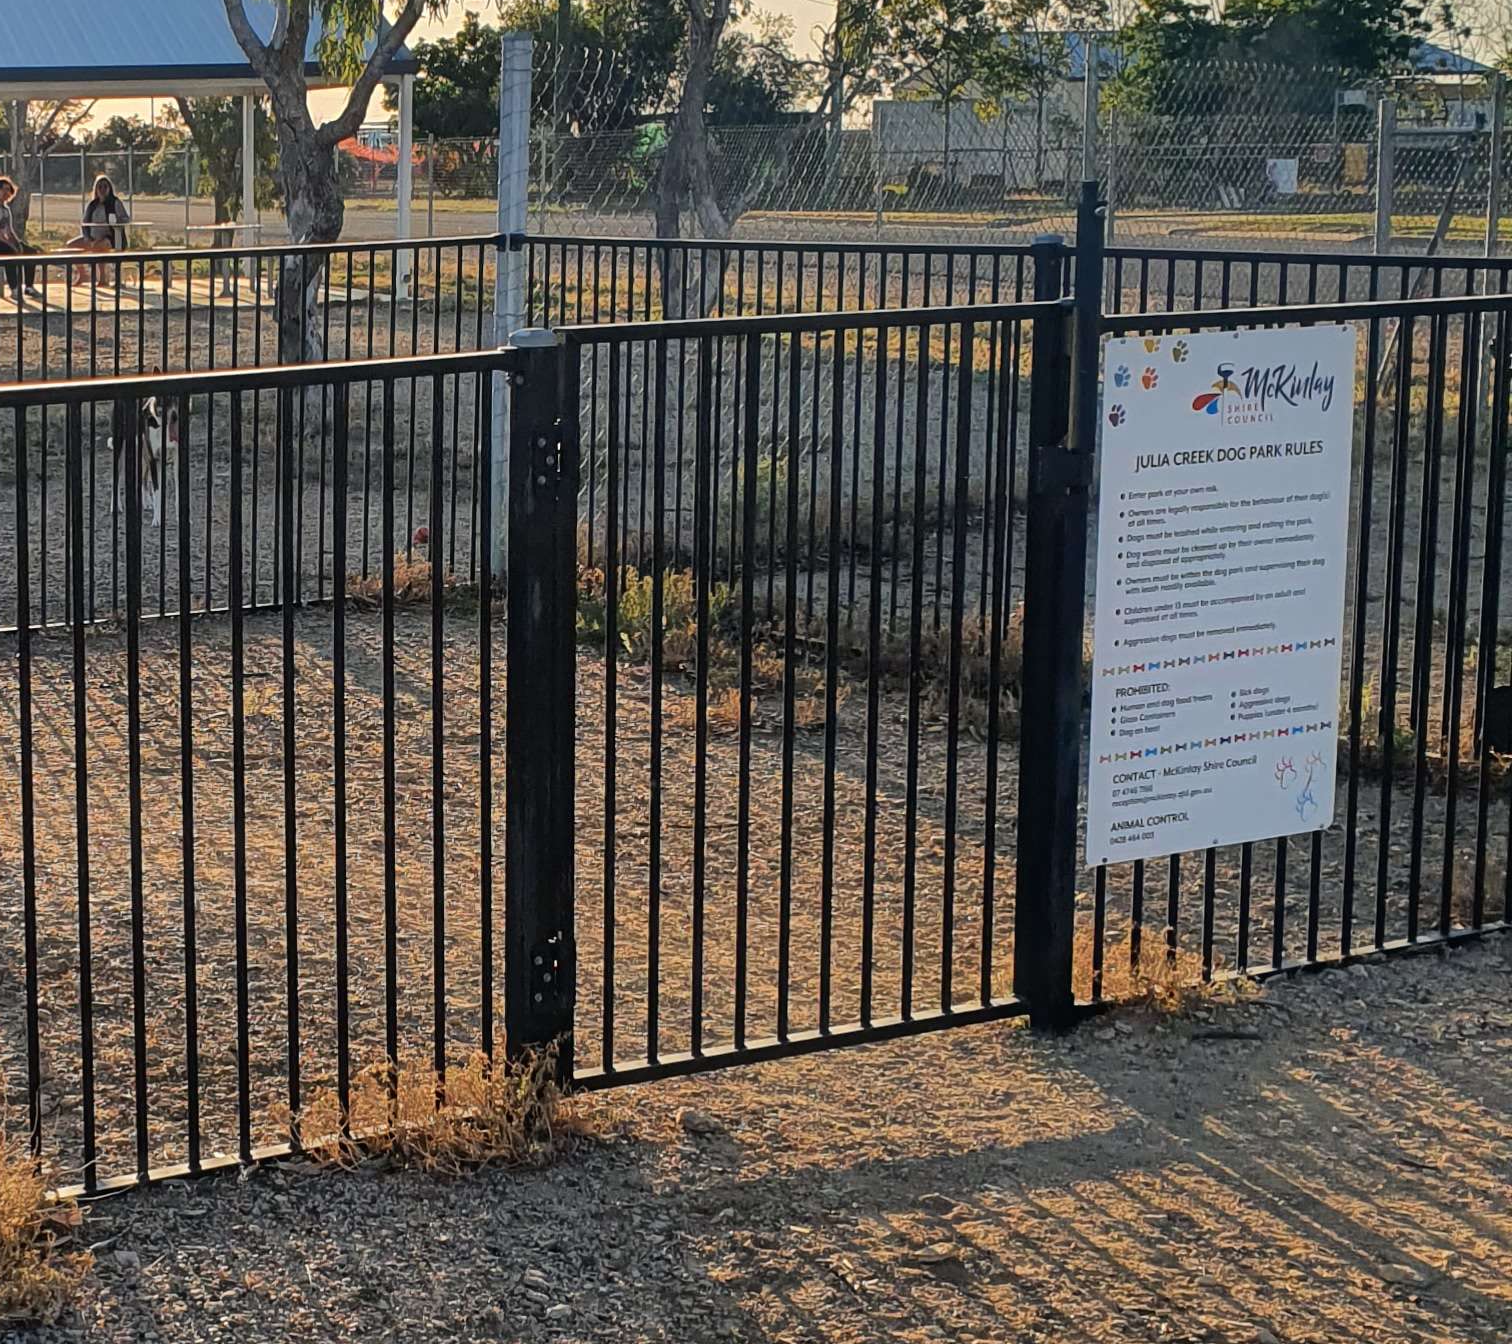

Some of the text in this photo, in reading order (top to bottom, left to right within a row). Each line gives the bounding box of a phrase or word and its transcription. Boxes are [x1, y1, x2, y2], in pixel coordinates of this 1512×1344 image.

[1241, 361, 1334, 412] McKinlay
[1228, 403, 1258, 413] SHIRE
[1228, 414, 1274, 424] COUNCIL
[1135, 440, 1323, 472] JULIA CREEK DOG PARK RULES
[1148, 491, 1163, 500] park
[1174, 489, 1188, 497] your
[1129, 509, 1153, 517] Owners
[1128, 534, 1144, 543] Dogs
[1127, 551, 1141, 559] Dog
[1229, 567, 1243, 575] park
[1312, 558, 1325, 566] dog
[1124, 607, 1152, 615] Children
[1113, 770, 1156, 783] CONTACT
[1204, 761, 1224, 770] Shire
[1226, 755, 1257, 768] Council
[1111, 812, 1189, 832] ANIMAL CONTROL
